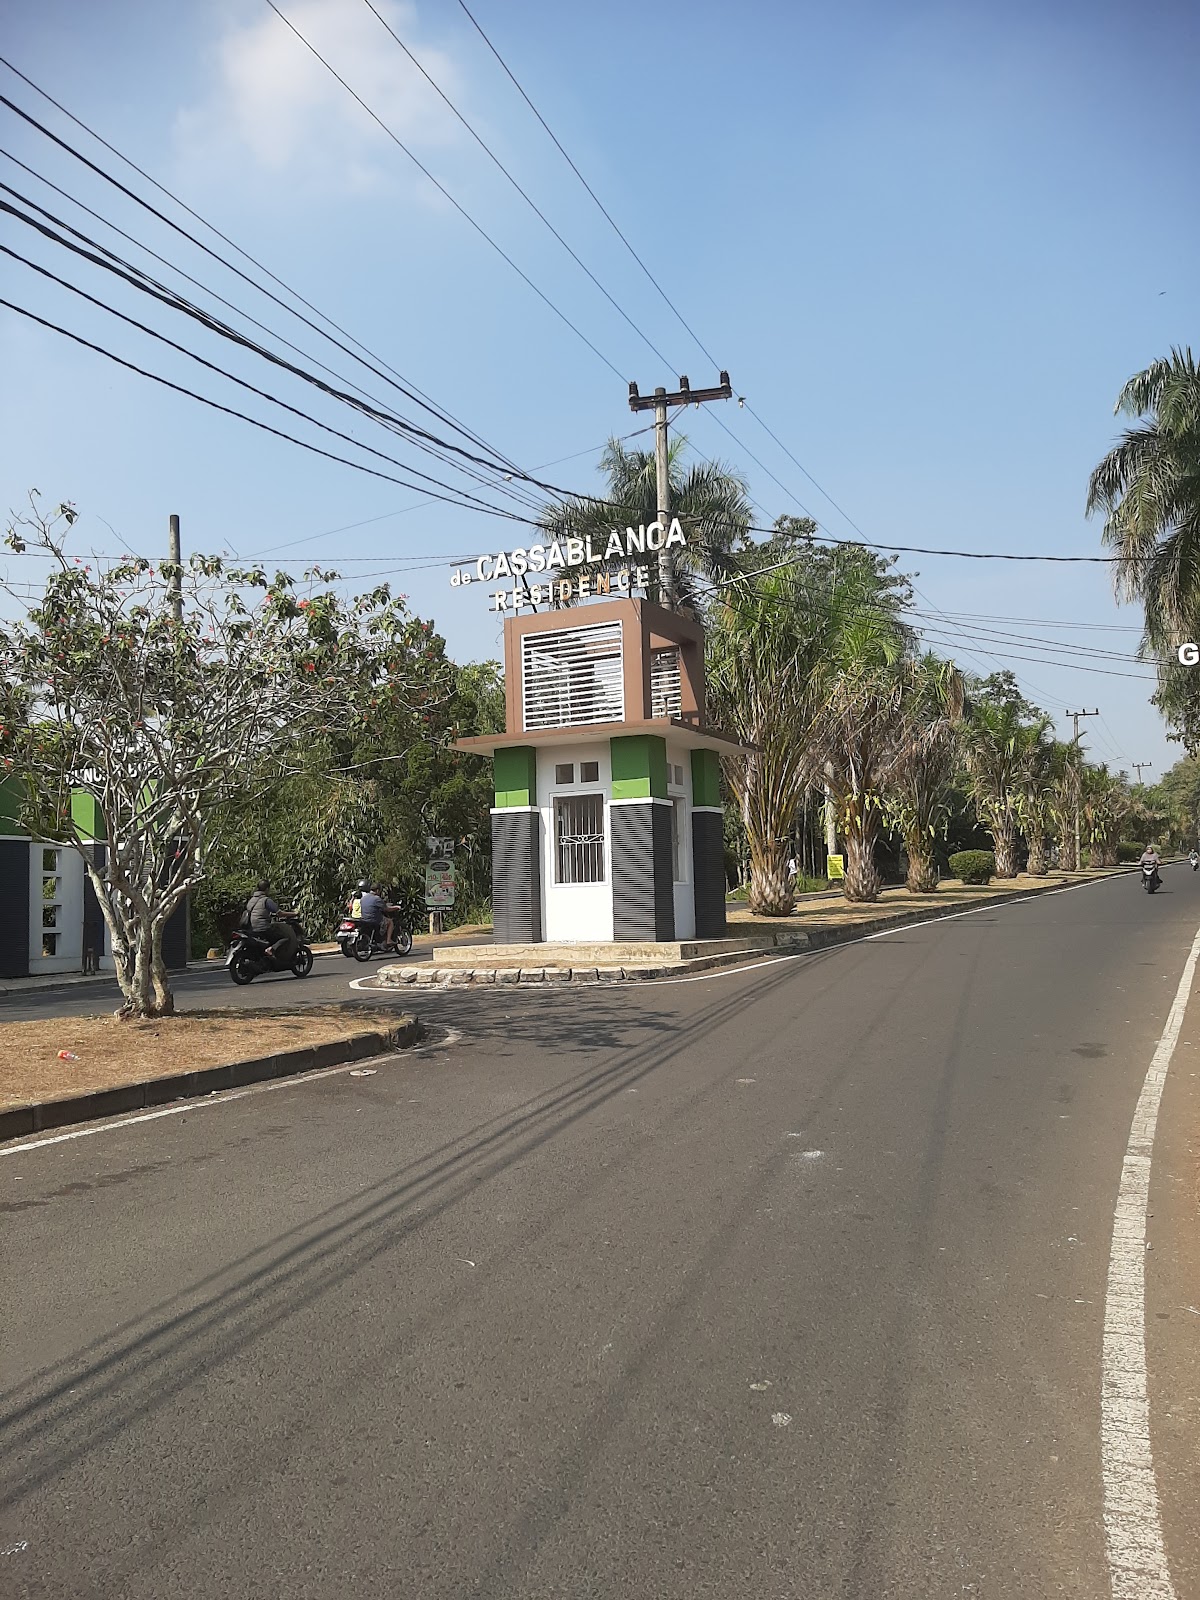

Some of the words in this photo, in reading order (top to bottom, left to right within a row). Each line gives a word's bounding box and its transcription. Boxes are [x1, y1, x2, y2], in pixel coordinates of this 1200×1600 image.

[450, 568, 472, 587] de
[476, 517, 687, 582] CASSABLANCA
[494, 565, 650, 611] RESIDENCE
